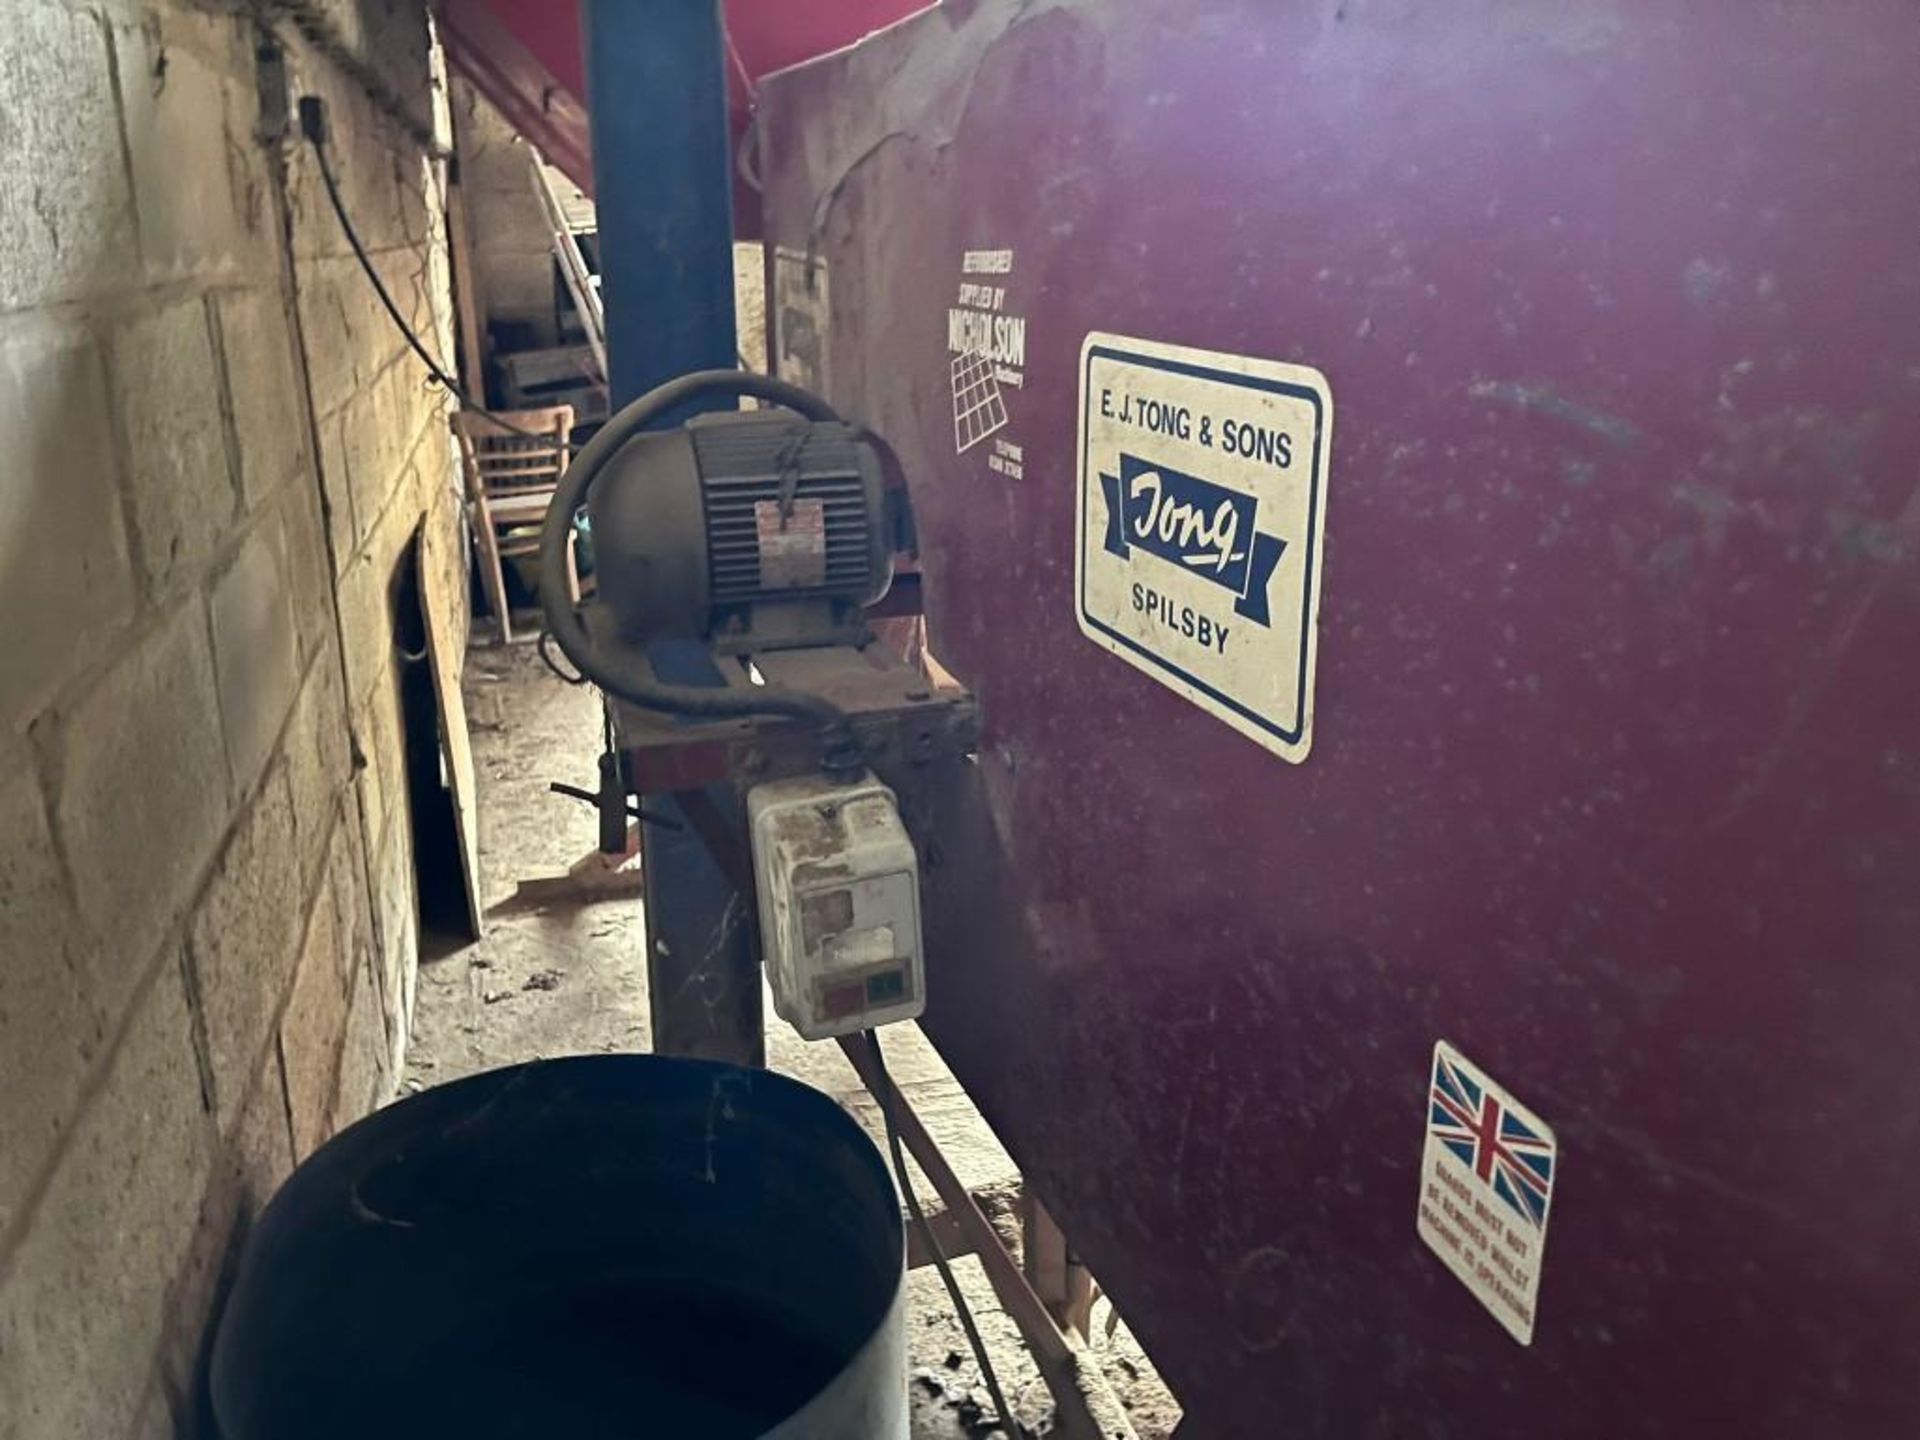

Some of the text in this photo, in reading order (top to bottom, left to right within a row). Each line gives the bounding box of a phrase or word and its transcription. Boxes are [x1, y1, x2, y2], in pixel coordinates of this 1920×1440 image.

[949, 308, 1025, 366] NICHOLSON
[1200, 415, 1213, 447] &
[1222, 419, 1292, 469] SONS
[1132, 582, 1229, 655] SPILSBY
[1475, 1199, 1504, 1236] MUST
